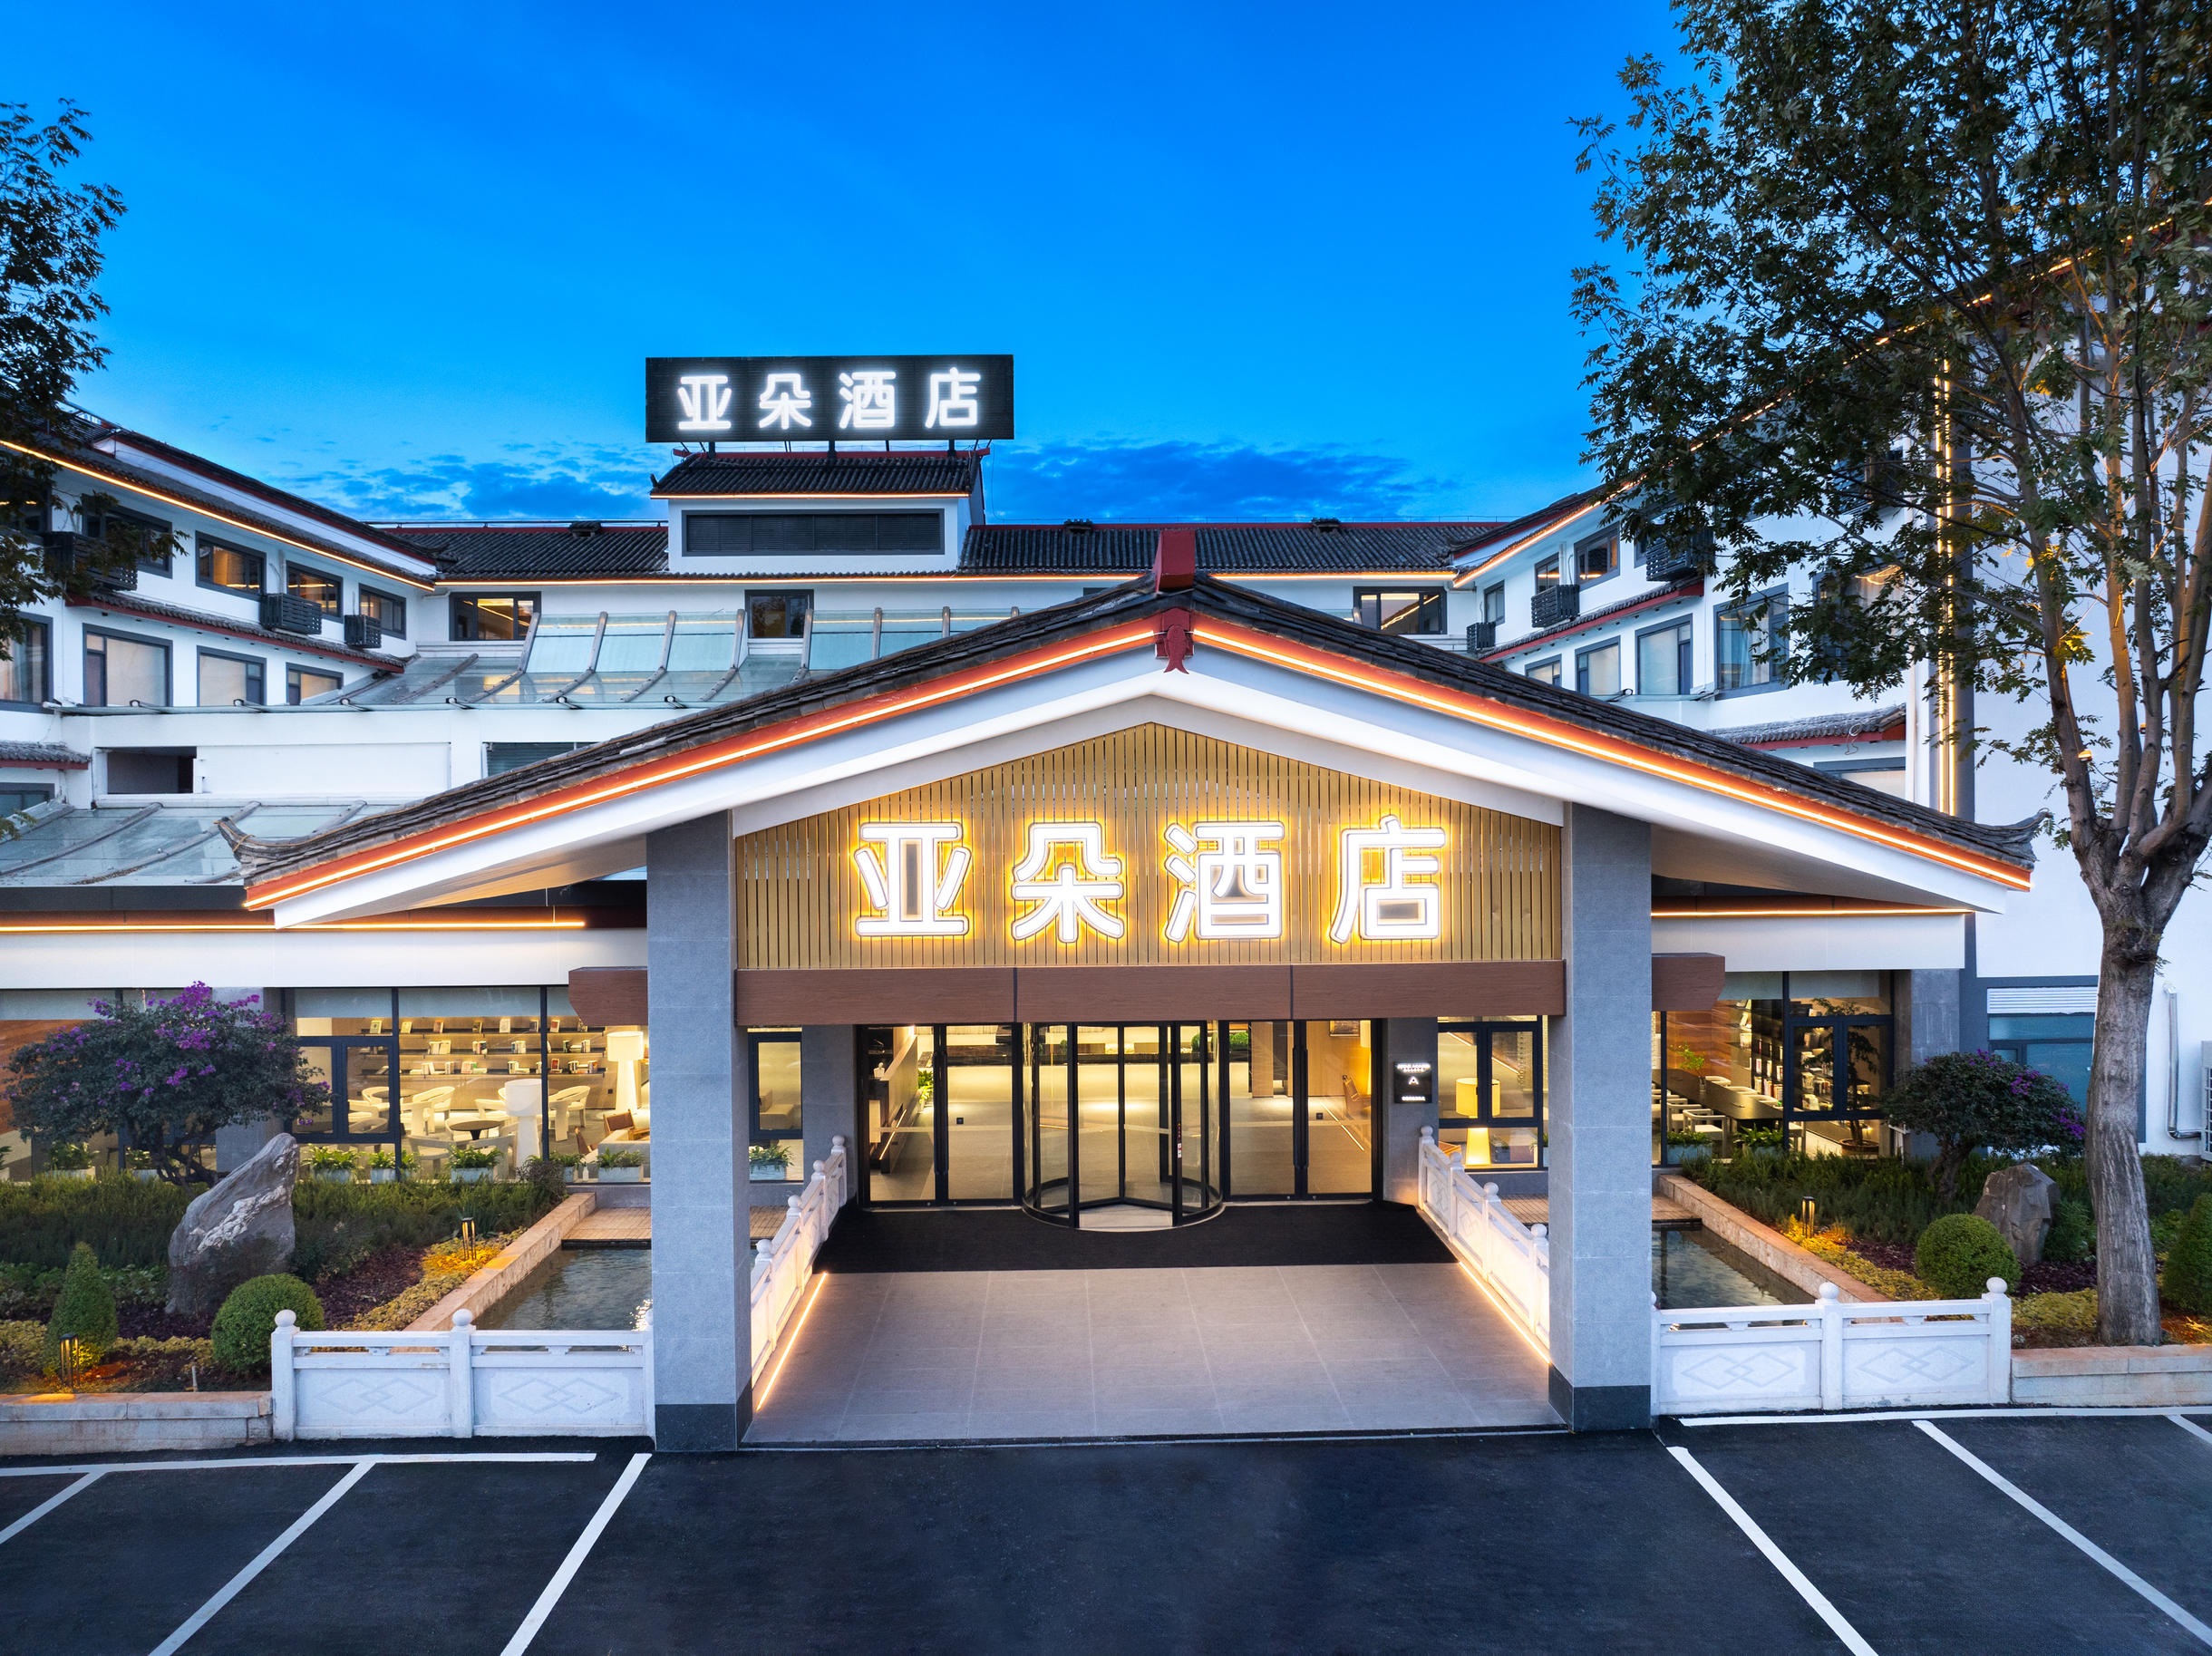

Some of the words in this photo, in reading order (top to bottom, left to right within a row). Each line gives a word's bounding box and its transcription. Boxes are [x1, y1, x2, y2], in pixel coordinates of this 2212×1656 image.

[678, 367, 981, 429] 亚朵酒店
[854, 815, 1446, 943] 亚朵酒店
